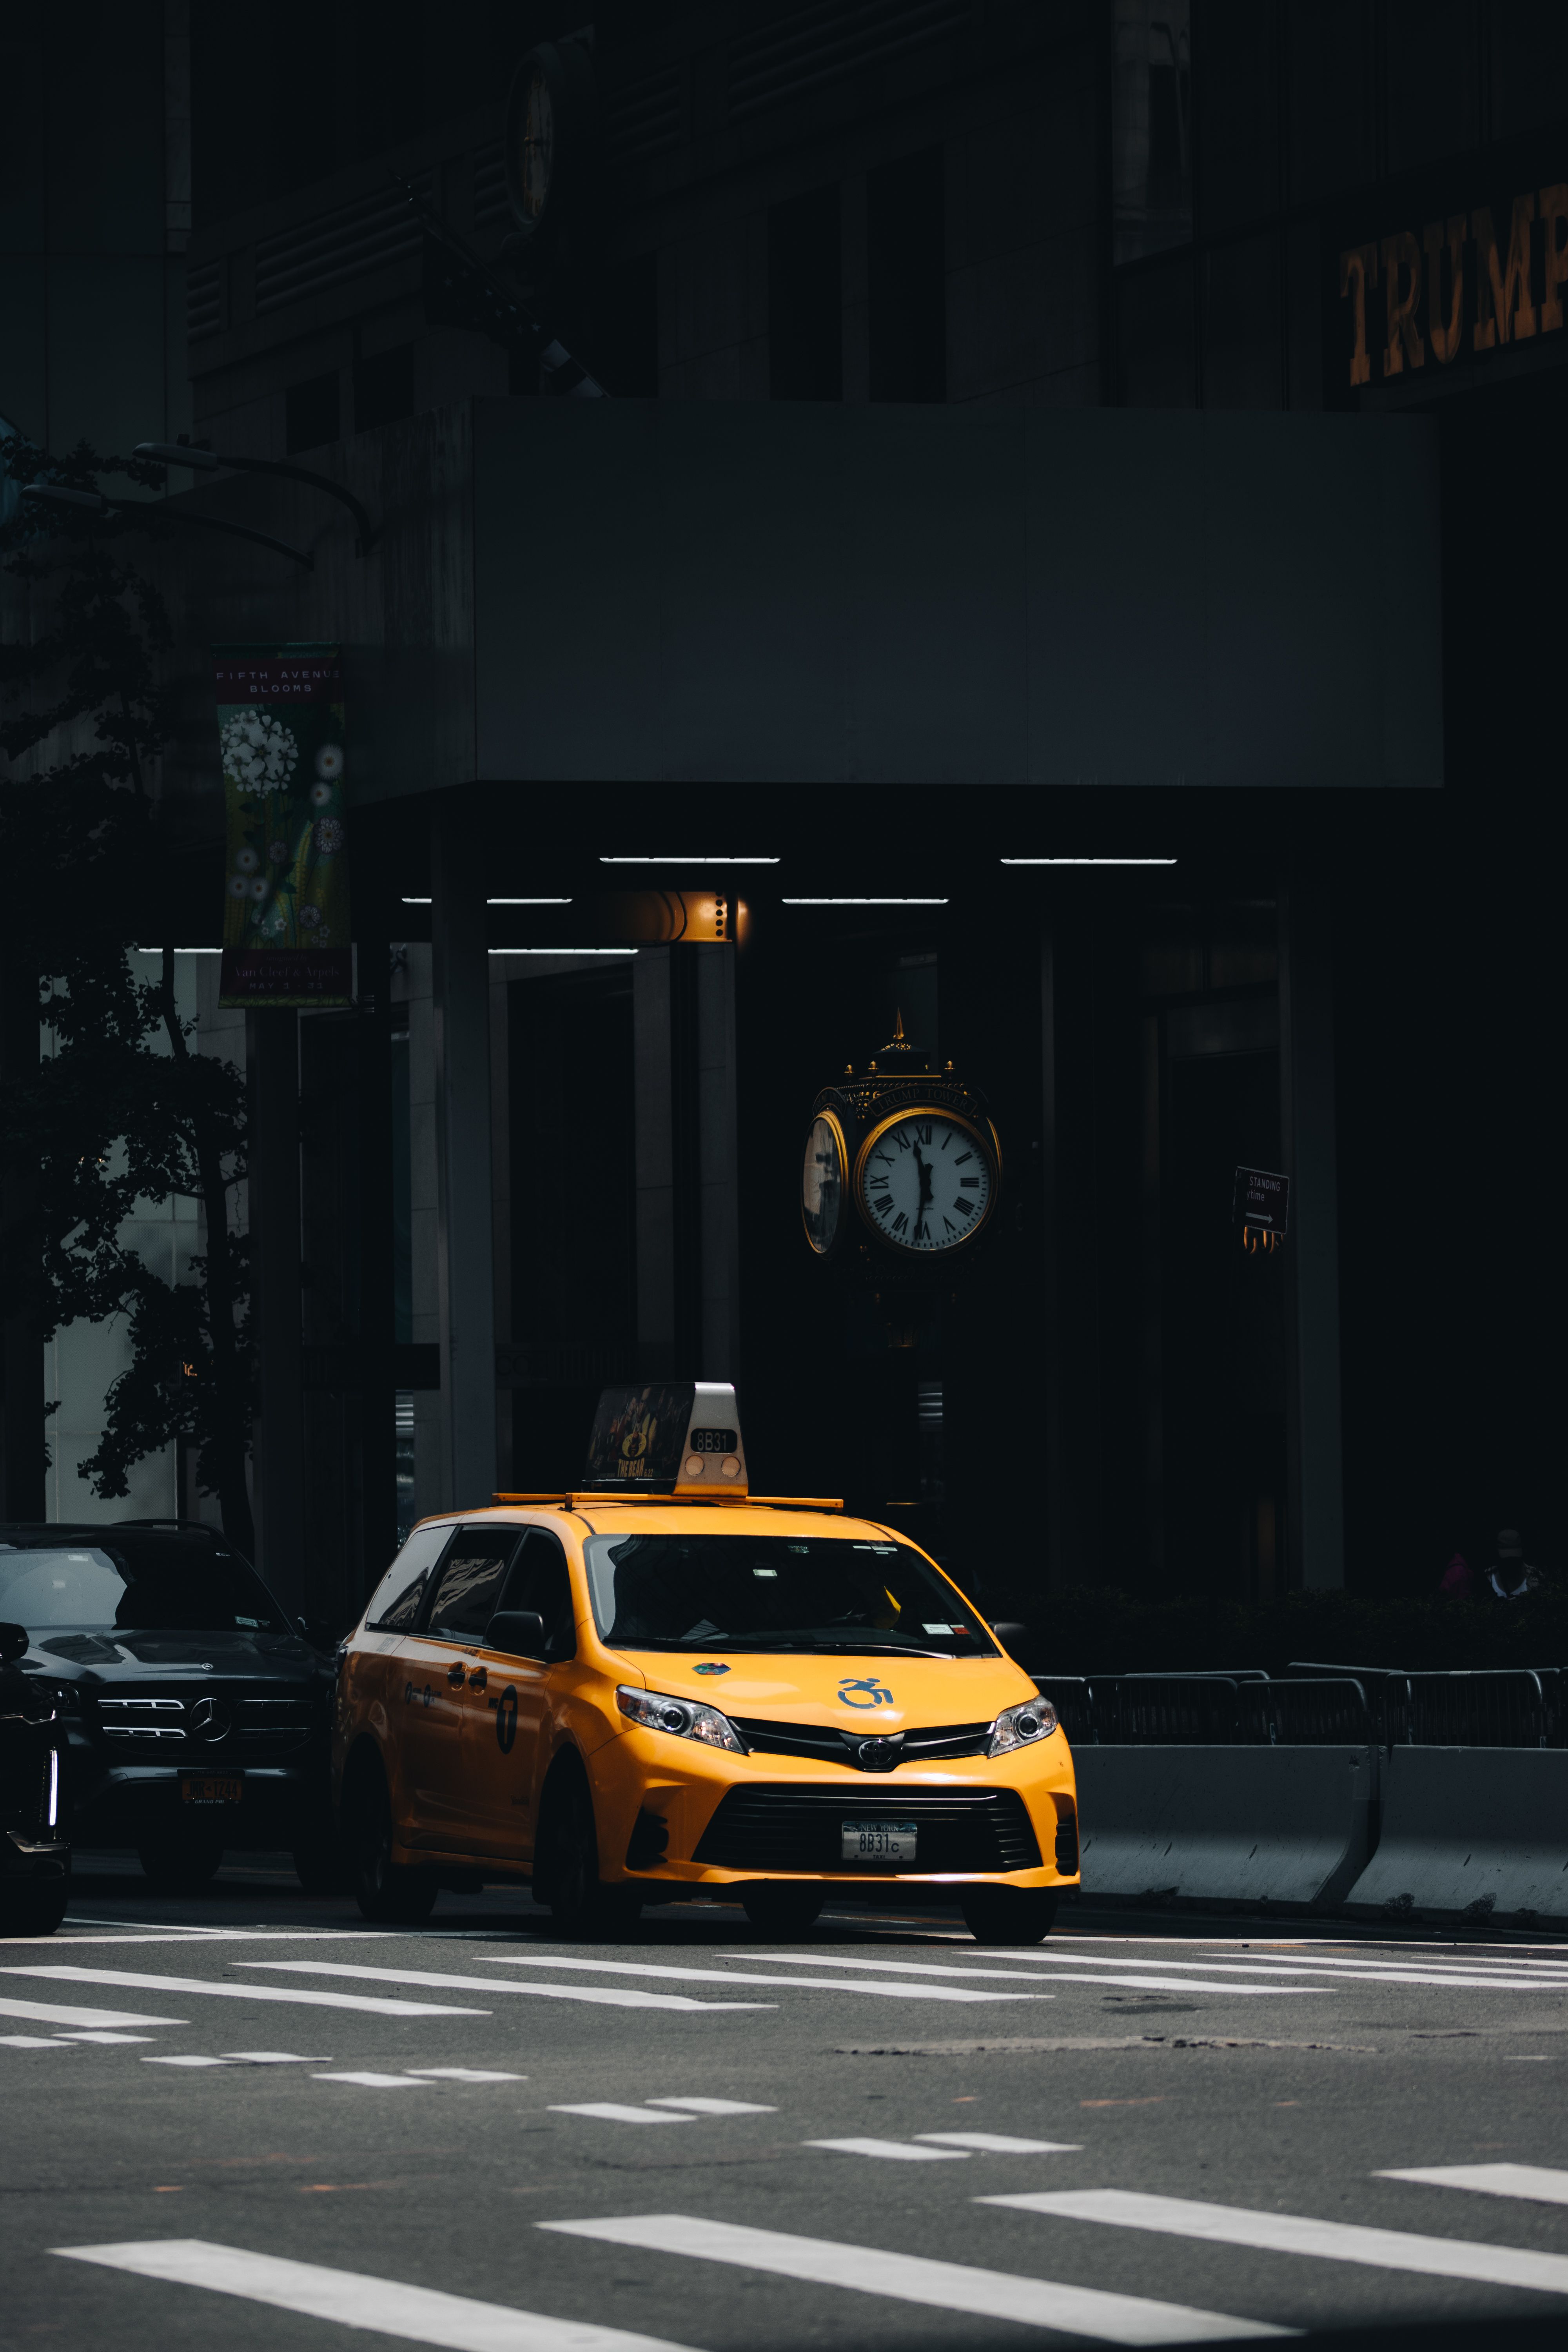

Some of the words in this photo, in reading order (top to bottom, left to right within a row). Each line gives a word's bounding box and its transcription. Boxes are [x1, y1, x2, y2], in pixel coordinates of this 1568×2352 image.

[1339, 183, 1568, 387] TRUMP
[216, 671, 268, 680] FIFTH
[281, 670, 339, 679] AVENUE
[250, 684, 312, 693] BLOOMS
[235, 967, 256, 977] Van
[260, 966, 290, 977] Cleef
[306, 966, 339, 980] Arpels
[875, 1088, 920, 1109] TRUMP
[926, 1088, 968, 1110] TOWER
[1249, 1176, 1281, 1192] STANDING
[1247, 1189, 1265, 1201] ytime
[697, 1432, 727, 1451] 8B31
[617, 1458, 628, 1477] THE
[628, 1457, 645, 1477] BEAR
